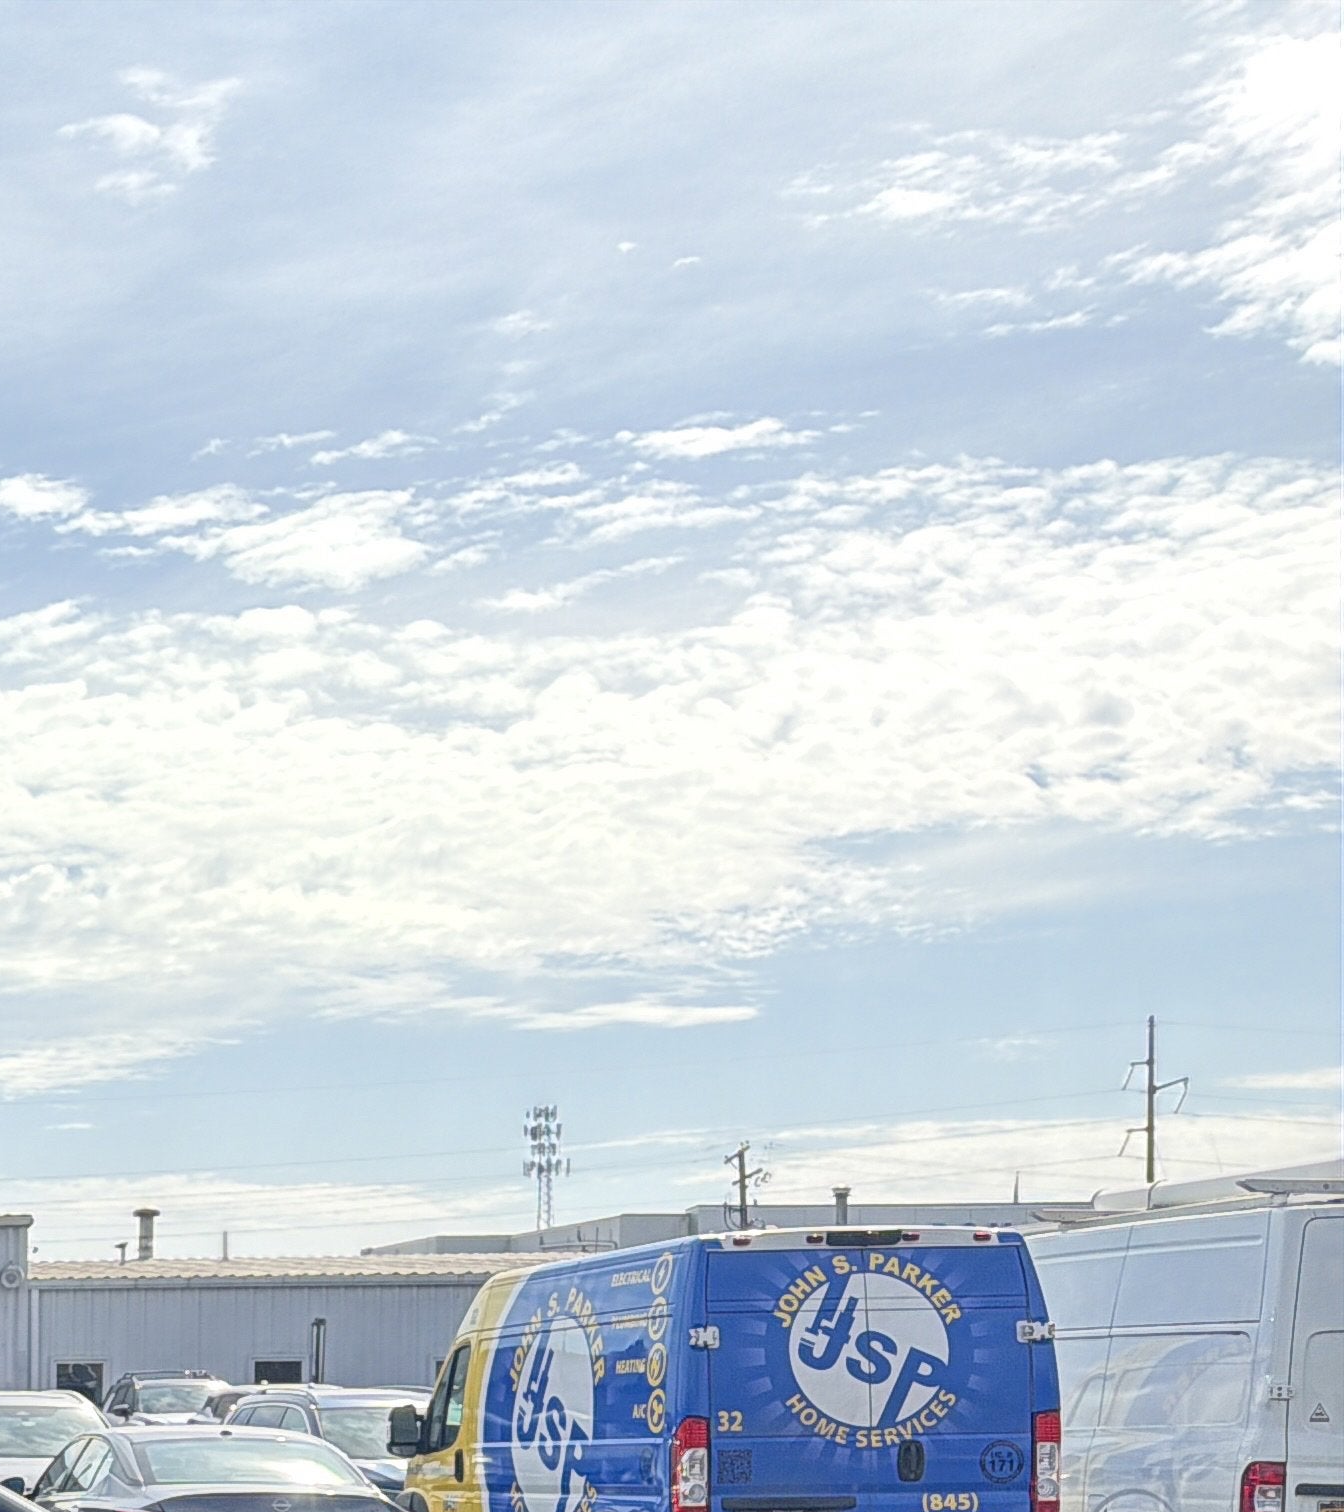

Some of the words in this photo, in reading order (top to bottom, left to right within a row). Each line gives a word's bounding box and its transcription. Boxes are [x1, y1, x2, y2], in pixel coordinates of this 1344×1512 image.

[611, 1268, 652, 1287] ELECTRICAL
[773, 1265, 827, 1328] JOHN
[831, 1255, 858, 1275] S.
[869, 1253, 962, 1325] PARKER
[509, 1307, 543, 1392] JOHN
[565, 1288, 606, 1386] PARKER
[615, 1359, 647, 1375] HEATING
[717, 1410, 743, 1432] 32
[785, 1393, 850, 1445] HOME
[855, 1389, 957, 1448] SERVICES
[988, 1459, 1015, 1472] 171
[922, 1491, 979, 1512] (845)
